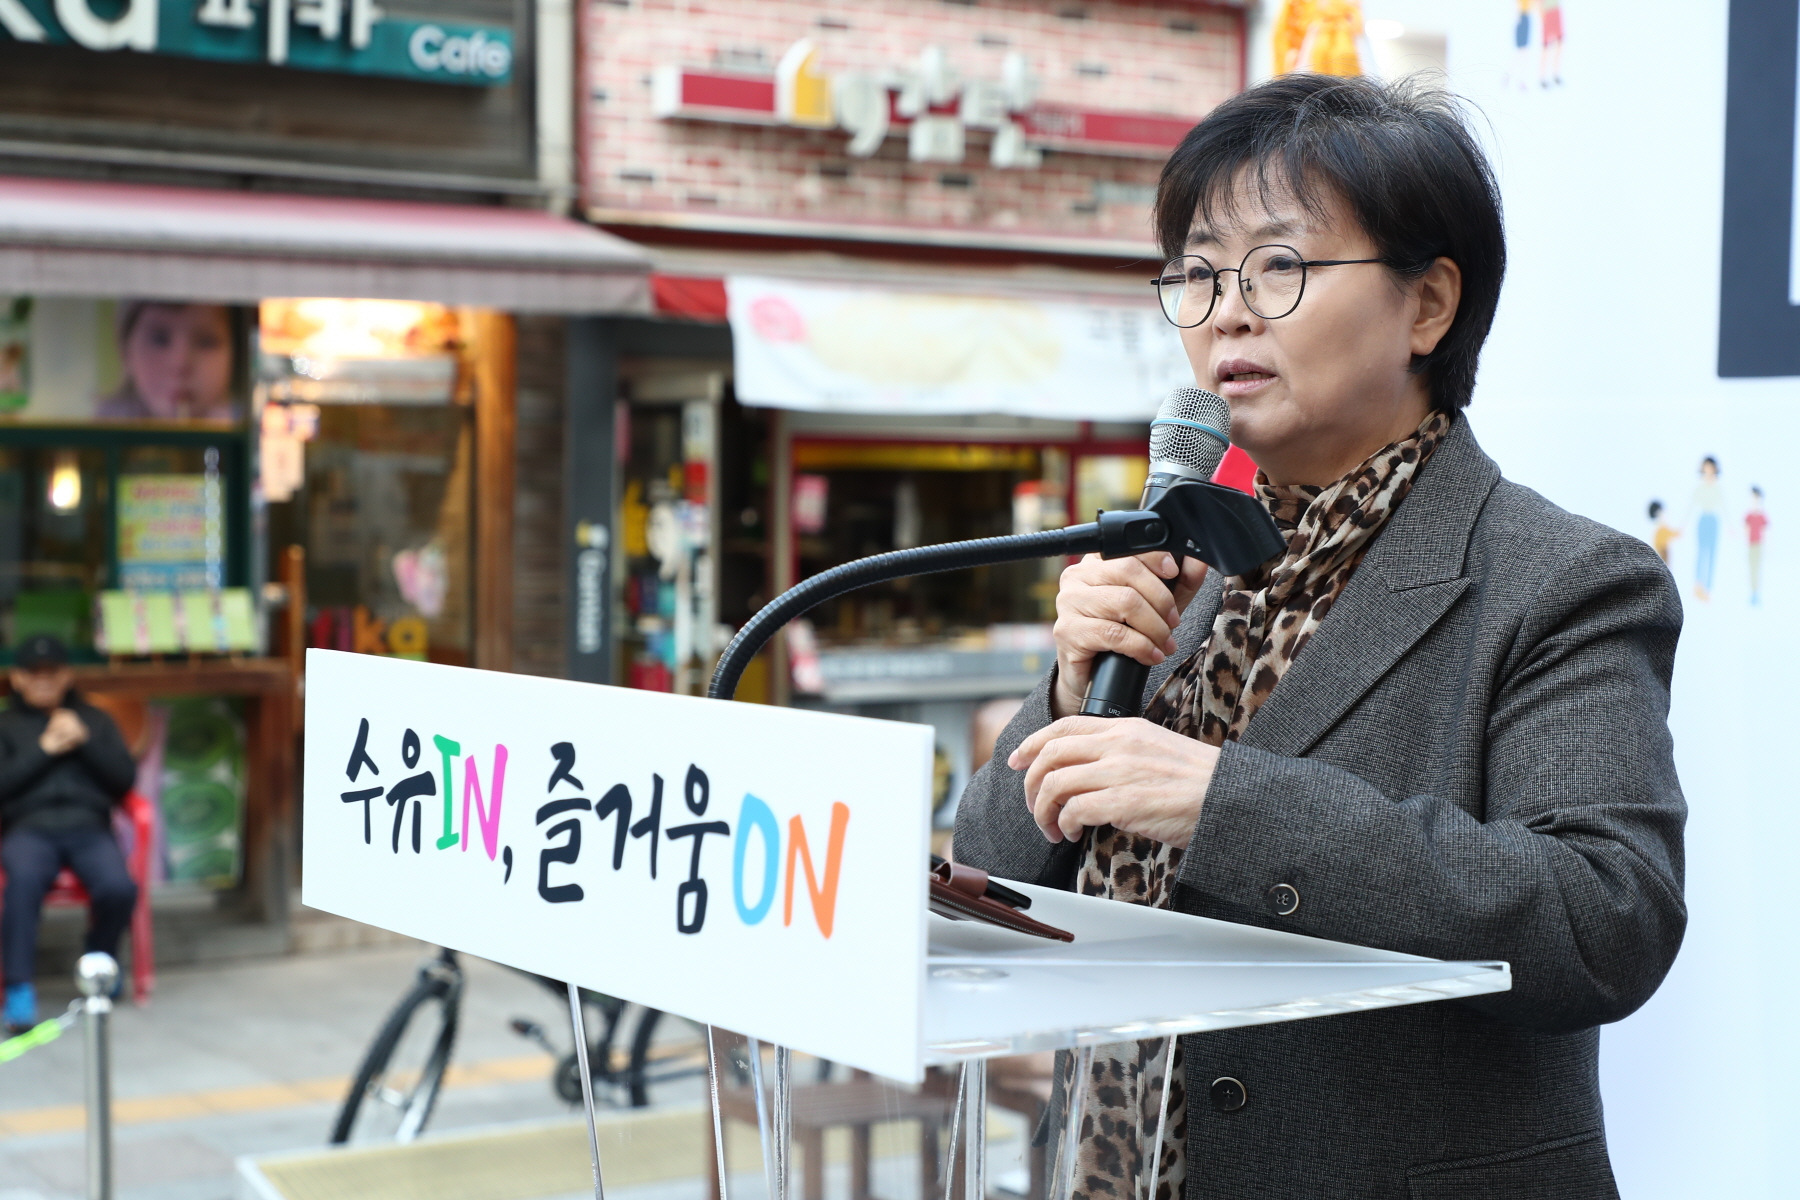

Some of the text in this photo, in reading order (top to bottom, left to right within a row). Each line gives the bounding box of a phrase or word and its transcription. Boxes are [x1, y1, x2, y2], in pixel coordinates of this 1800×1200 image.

[408, 24, 511, 77] Cafe
[340, 717, 850, 940] 수유IN, 즐거움ON
